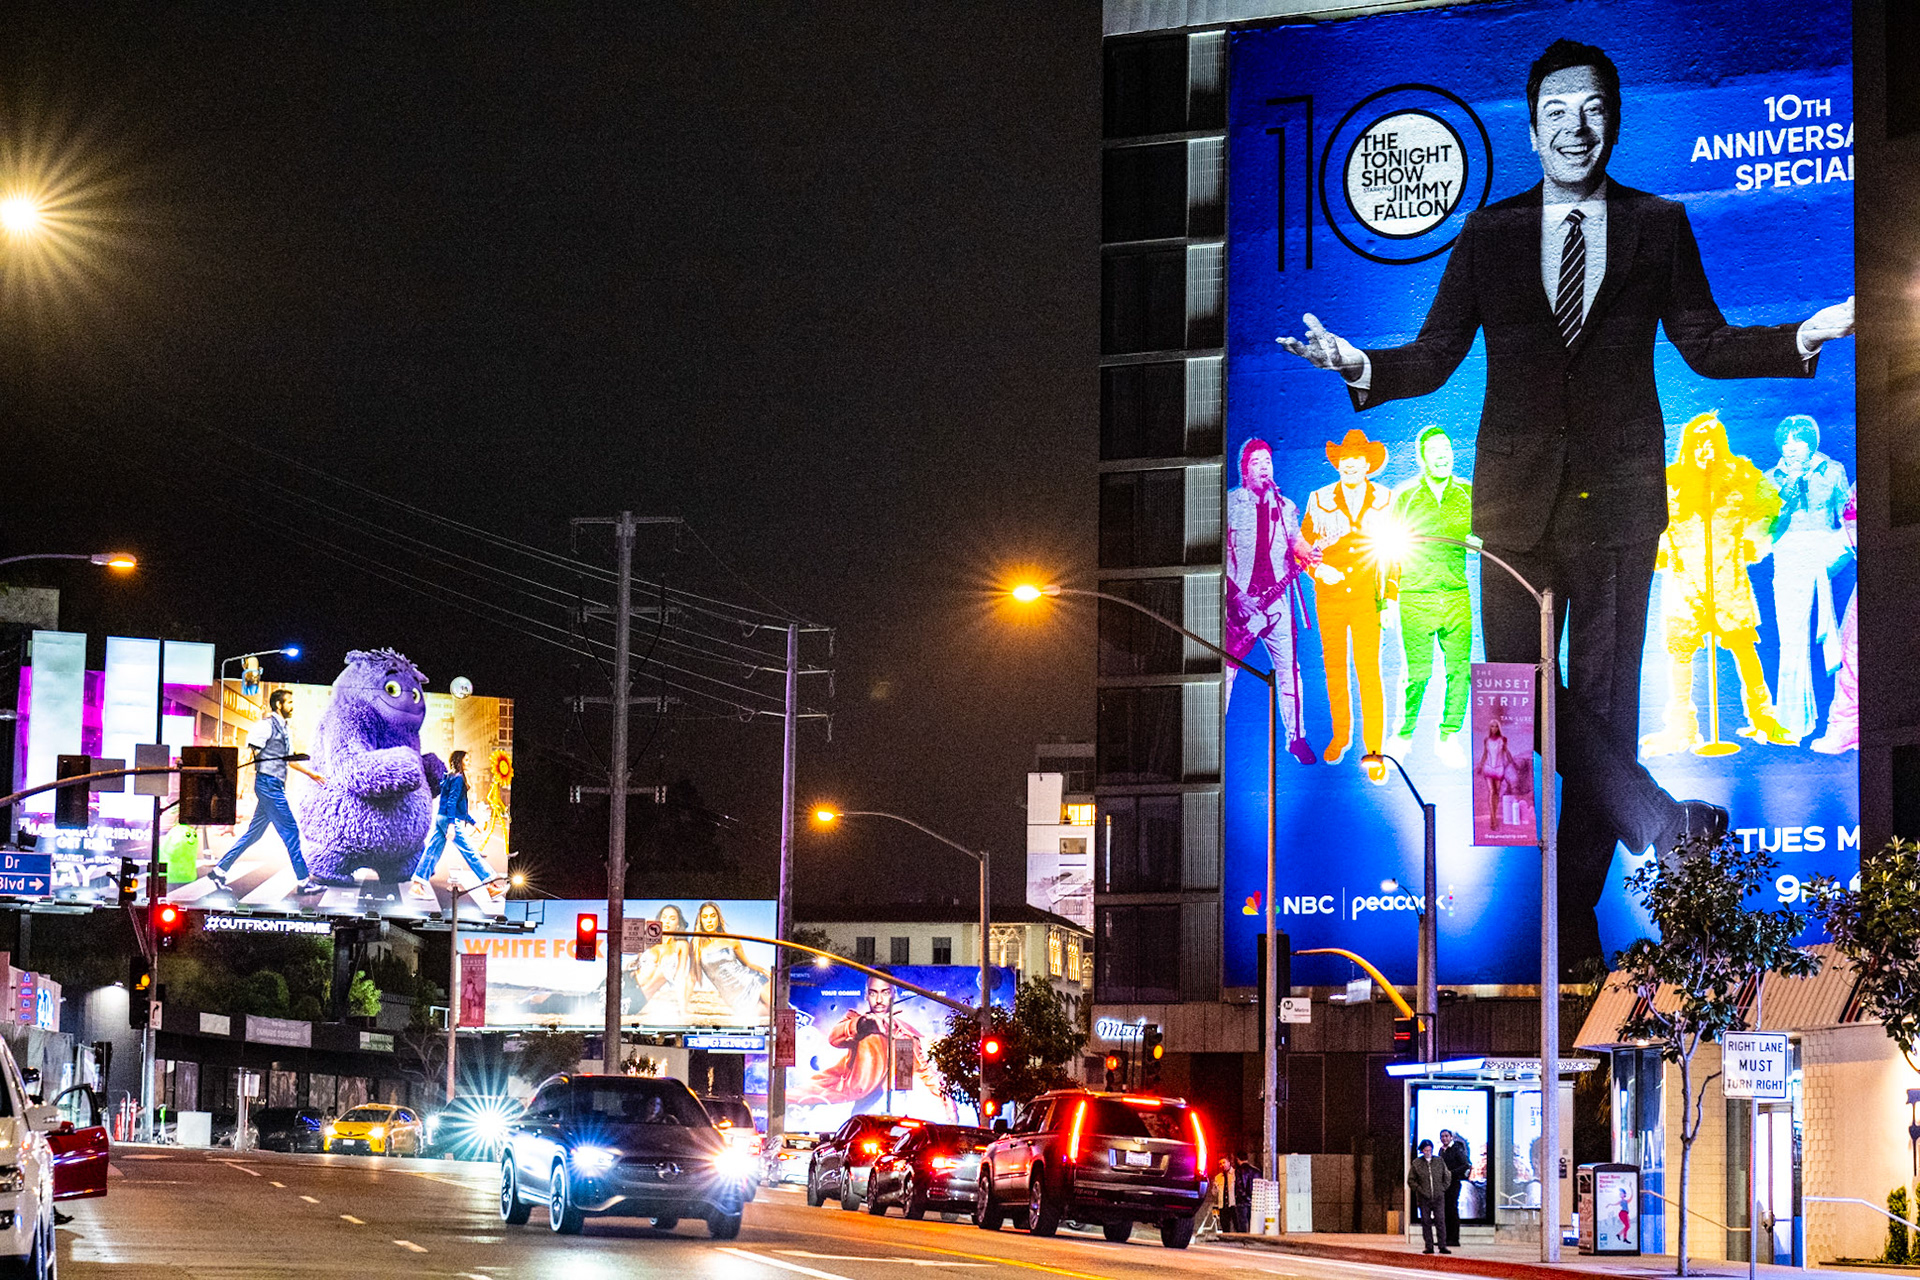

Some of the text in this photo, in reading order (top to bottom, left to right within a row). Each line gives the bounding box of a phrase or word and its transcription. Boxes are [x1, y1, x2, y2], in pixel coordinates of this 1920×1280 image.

[1764, 94, 1831, 122] 10TH
[1362, 132, 1398, 152] THE
[1361, 145, 1452, 169] TONIGHT
[1361, 165, 1424, 187] SHOW
[1386, 180, 1453, 203] JIMMY
[1374, 199, 1448, 221] FALLON
[1476, 679, 1530, 689] SUNSET
[1477, 696, 1529, 707] STRIP
[1736, 825, 1826, 853] TUES
[5, 855, 20, 869] Dr
[1284, 895, 1334, 914] NBC
[205, 915, 331, 934] #OUTFRONTPRIME
[463, 939, 547, 958] WHITE
[1728, 1041, 1783, 1053] RIGHT LANE
[1739, 1059, 1772, 1072] MUST
[1727, 1079, 1783, 1090] TURN RIGHT
